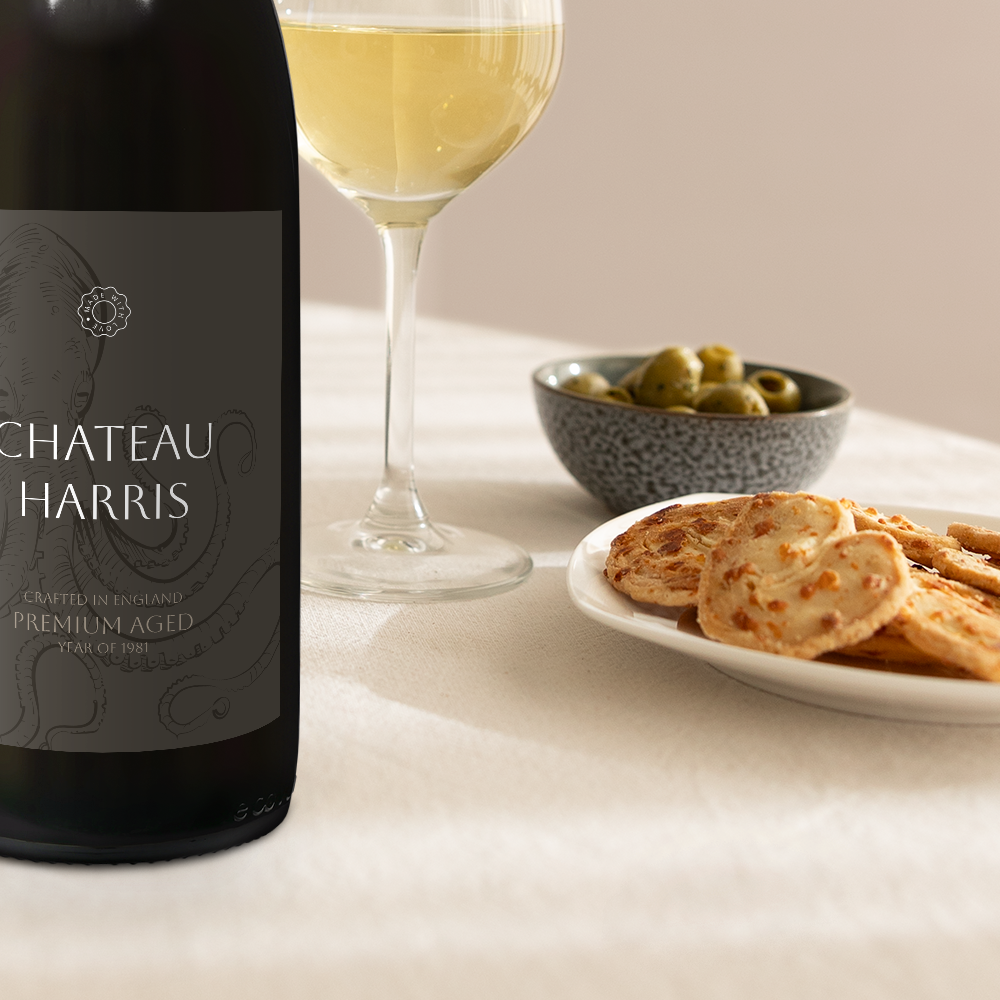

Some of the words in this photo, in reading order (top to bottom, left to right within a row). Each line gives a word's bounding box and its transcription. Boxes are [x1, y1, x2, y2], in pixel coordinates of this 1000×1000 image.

[83, 292, 105, 313] MADE
[111, 294, 125, 319] WITH
[91, 322, 119, 332] LOVE
[21, 480, 189, 520] HARRIS
[23, 590, 88, 606] CRAFTED
[93, 594, 108, 606] IN
[114, 591, 183, 606] ENGLAND
[14, 611, 121, 635] PREMIUM
[129, 612, 194, 634] AGED
[58, 641, 93, 654] YEAR
[97, 642, 117, 654] OF
[121, 641, 148, 654] 1981
